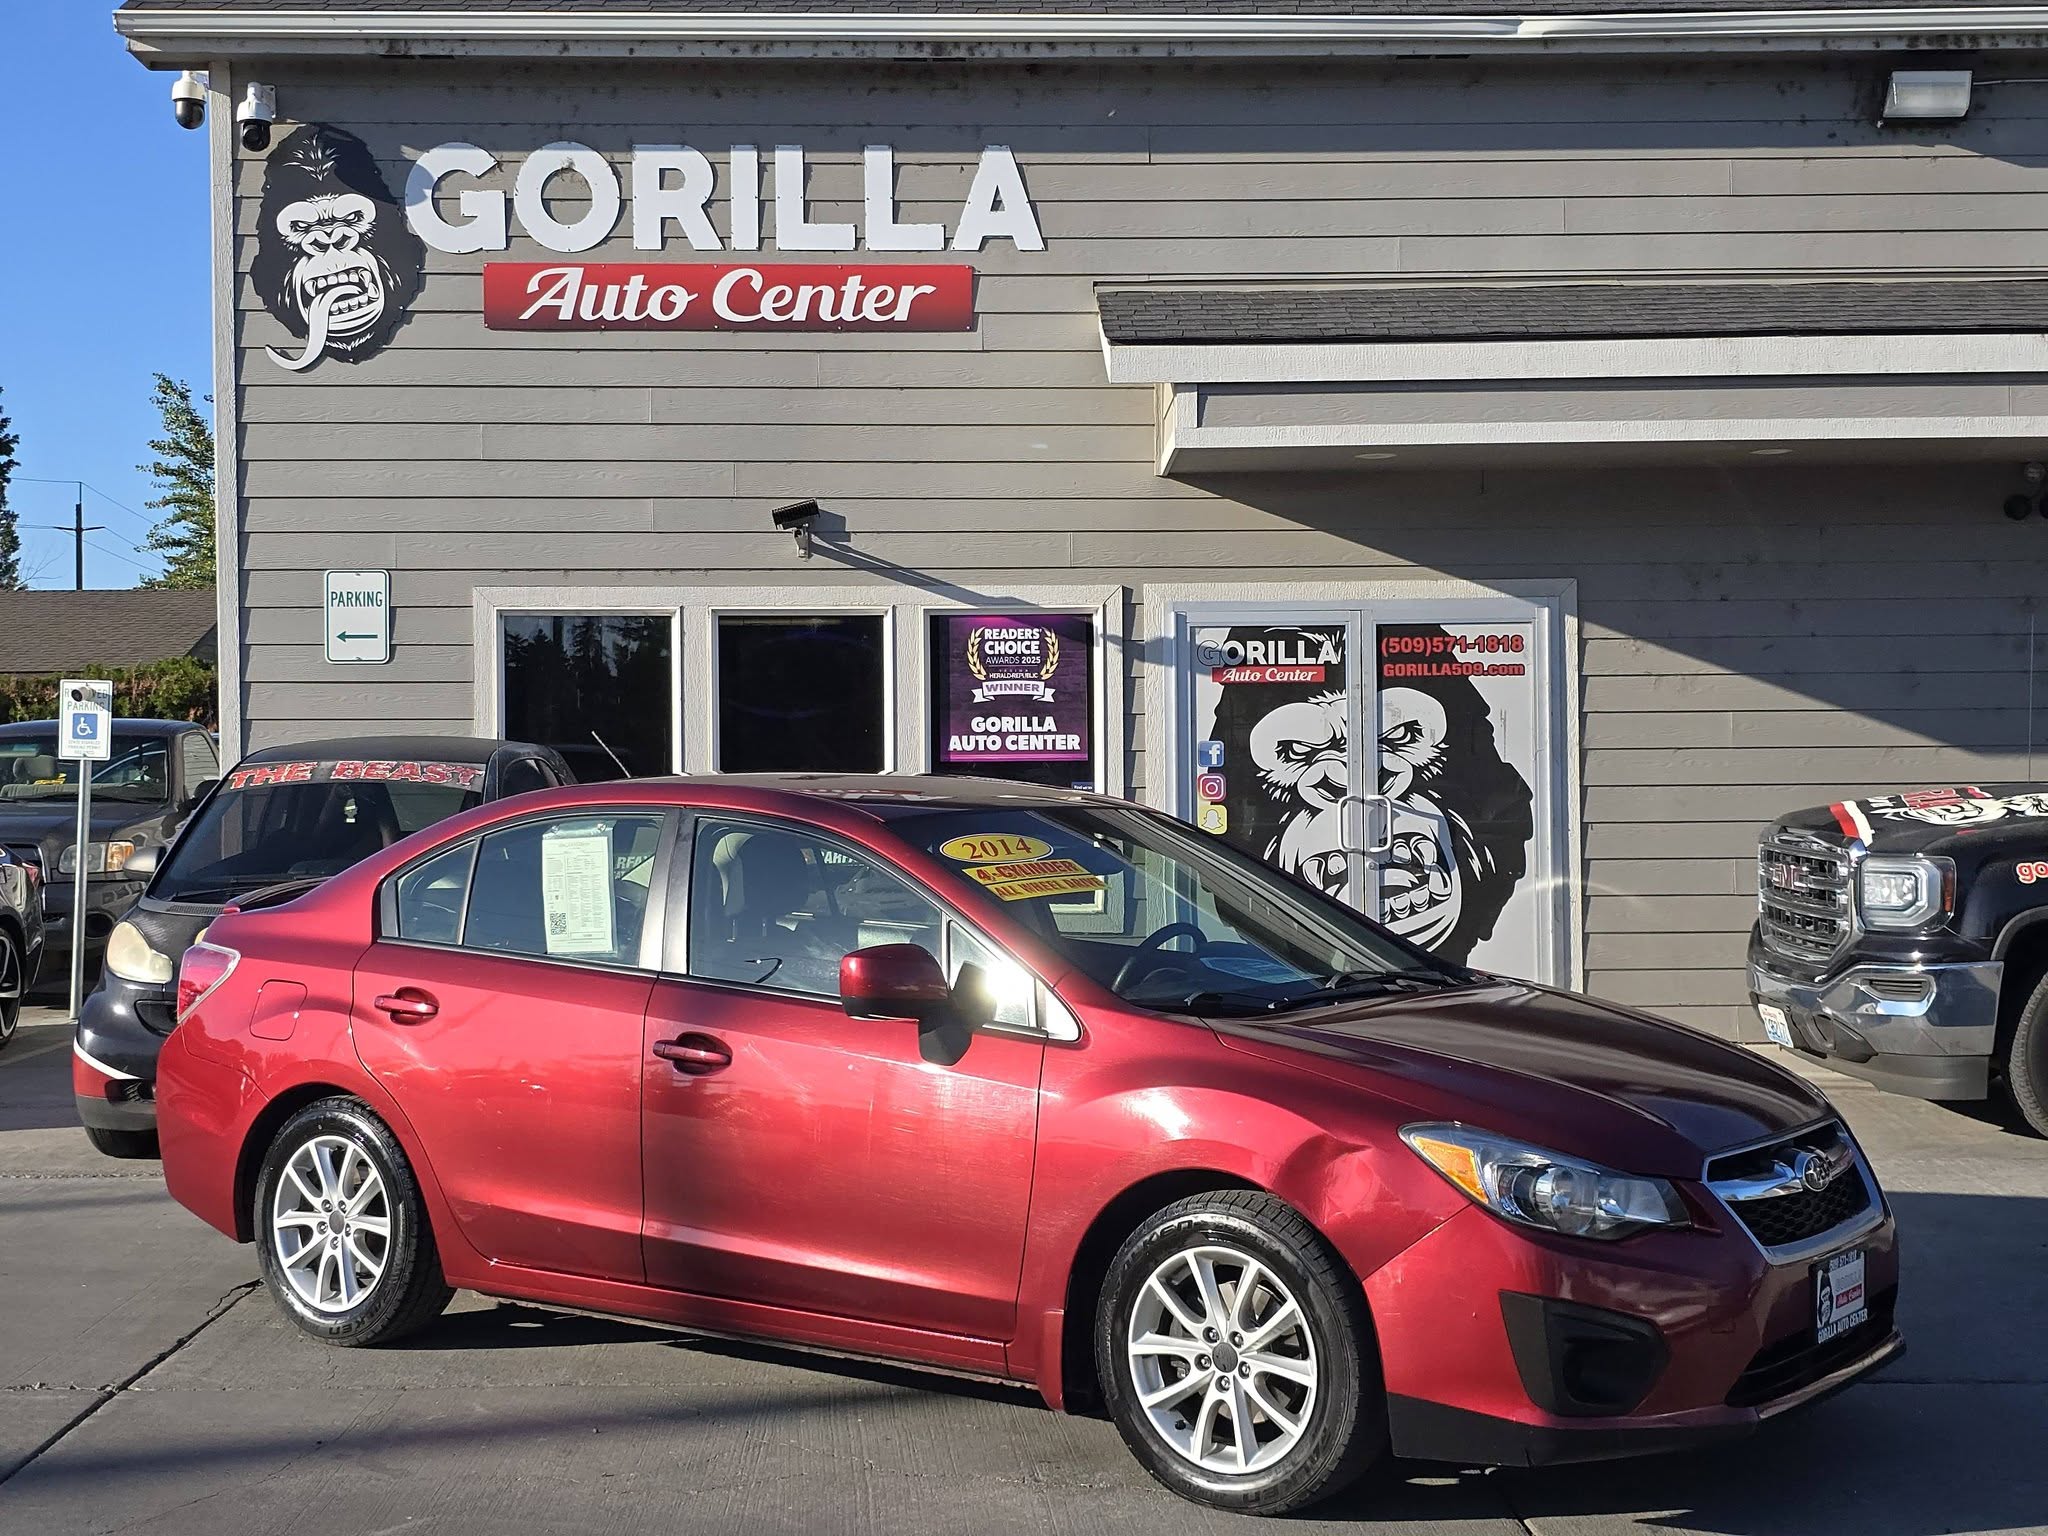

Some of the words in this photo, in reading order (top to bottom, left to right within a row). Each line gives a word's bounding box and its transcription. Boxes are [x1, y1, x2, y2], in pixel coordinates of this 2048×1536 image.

[405, 140, 1044, 253] GORILLA
[519, 266, 699, 323] Auto
[711, 266, 936, 323] Center
[330, 590, 383, 608] PARKING
[984, 627, 1043, 640] READERS'
[984, 640, 1040, 655] CHOICE
[1197, 639, 1339, 666] GORILLA
[1381, 634, 1525, 657] (509)571-1818
[985, 656, 1021, 665] AWARDS
[1021, 656, 1041, 665] 2025
[1382, 661, 1526, 677] GORILLA509.com
[1221, 667, 1264, 682] Auto
[1265, 667, 1318, 682] Center
[985, 683, 1040, 692] WINNER
[67, 701, 105, 712] PARKING
[970, 715, 1058, 733] GORILLA
[948, 734, 1002, 751] AUTO
[1005, 734, 1081, 751] CENTER
[228, 761, 318, 789] THE
[330, 760, 485, 786] BEAST
[961, 837, 1032, 860] 2014
[976, 859, 1079, 882] 4-CYLINDER
[2016, 861, 2048, 884] go
[994, 885, 1021, 898] ALL
[1018, 881, 1063, 894] WHEEL
[1063, 876, 1105, 889] DRIVE
